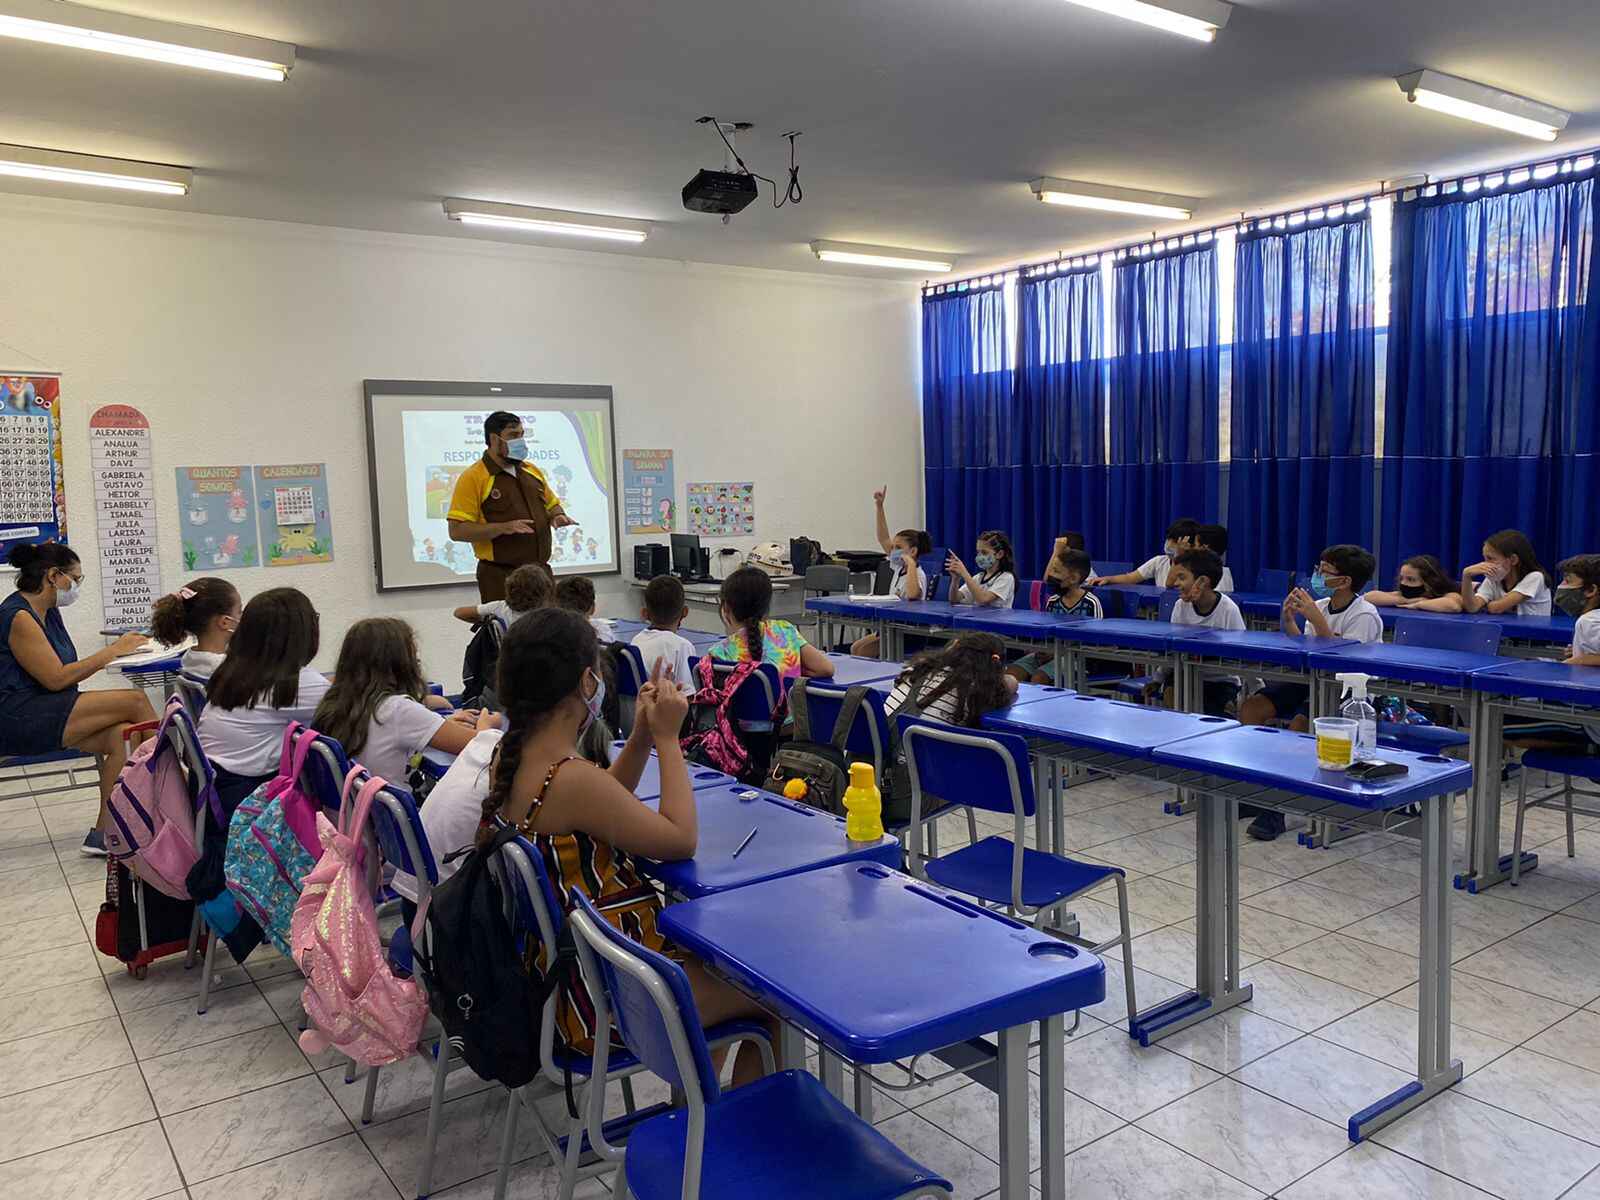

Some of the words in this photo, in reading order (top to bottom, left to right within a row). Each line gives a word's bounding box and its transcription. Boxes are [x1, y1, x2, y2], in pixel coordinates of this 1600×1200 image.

[192, 467, 238, 478] QUANTOS
[104, 481, 143, 489] GUSTAVO
[200, 481, 233, 492] SOMOS
[103, 501, 149, 509] ISABBELLY
[115, 520, 140, 528] JULIA
[108, 529, 145, 537] LARISSA
[103, 548, 124, 557] LUIS
[125, 547, 153, 556] FELIPE
[109, 557, 151, 566] MANUELA
[115, 567, 146, 575] MARIA
[114, 577, 147, 585] MIGUEL
[112, 586, 151, 595] MILLENA
[113, 596, 151, 605] MIRIAM
[122, 606, 145, 615] NALU
[106, 616, 134, 625] PEDRO
[136, 615, 152, 624] LUC
